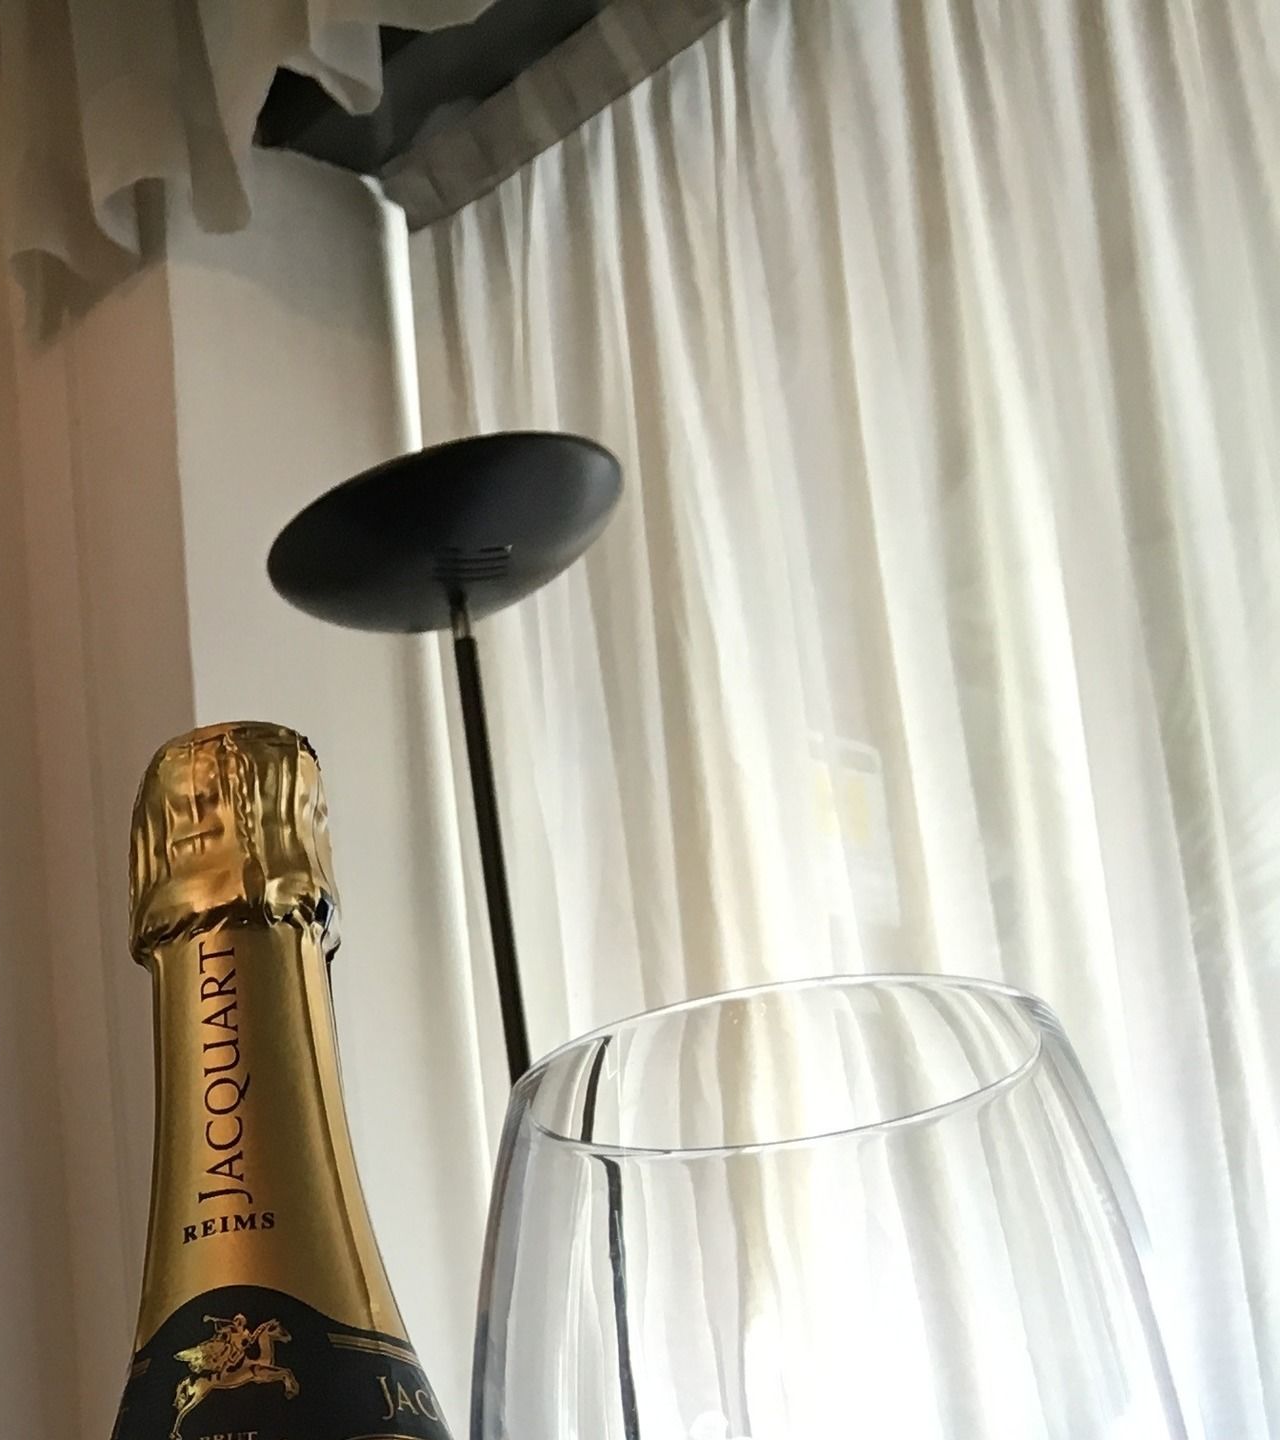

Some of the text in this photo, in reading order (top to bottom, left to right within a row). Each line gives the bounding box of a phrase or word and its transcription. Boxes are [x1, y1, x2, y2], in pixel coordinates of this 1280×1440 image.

[197, 942, 253, 1205] JACQUART
[182, 1212, 276, 1245] REIMS
[376, 1375, 440, 1422] JAC
